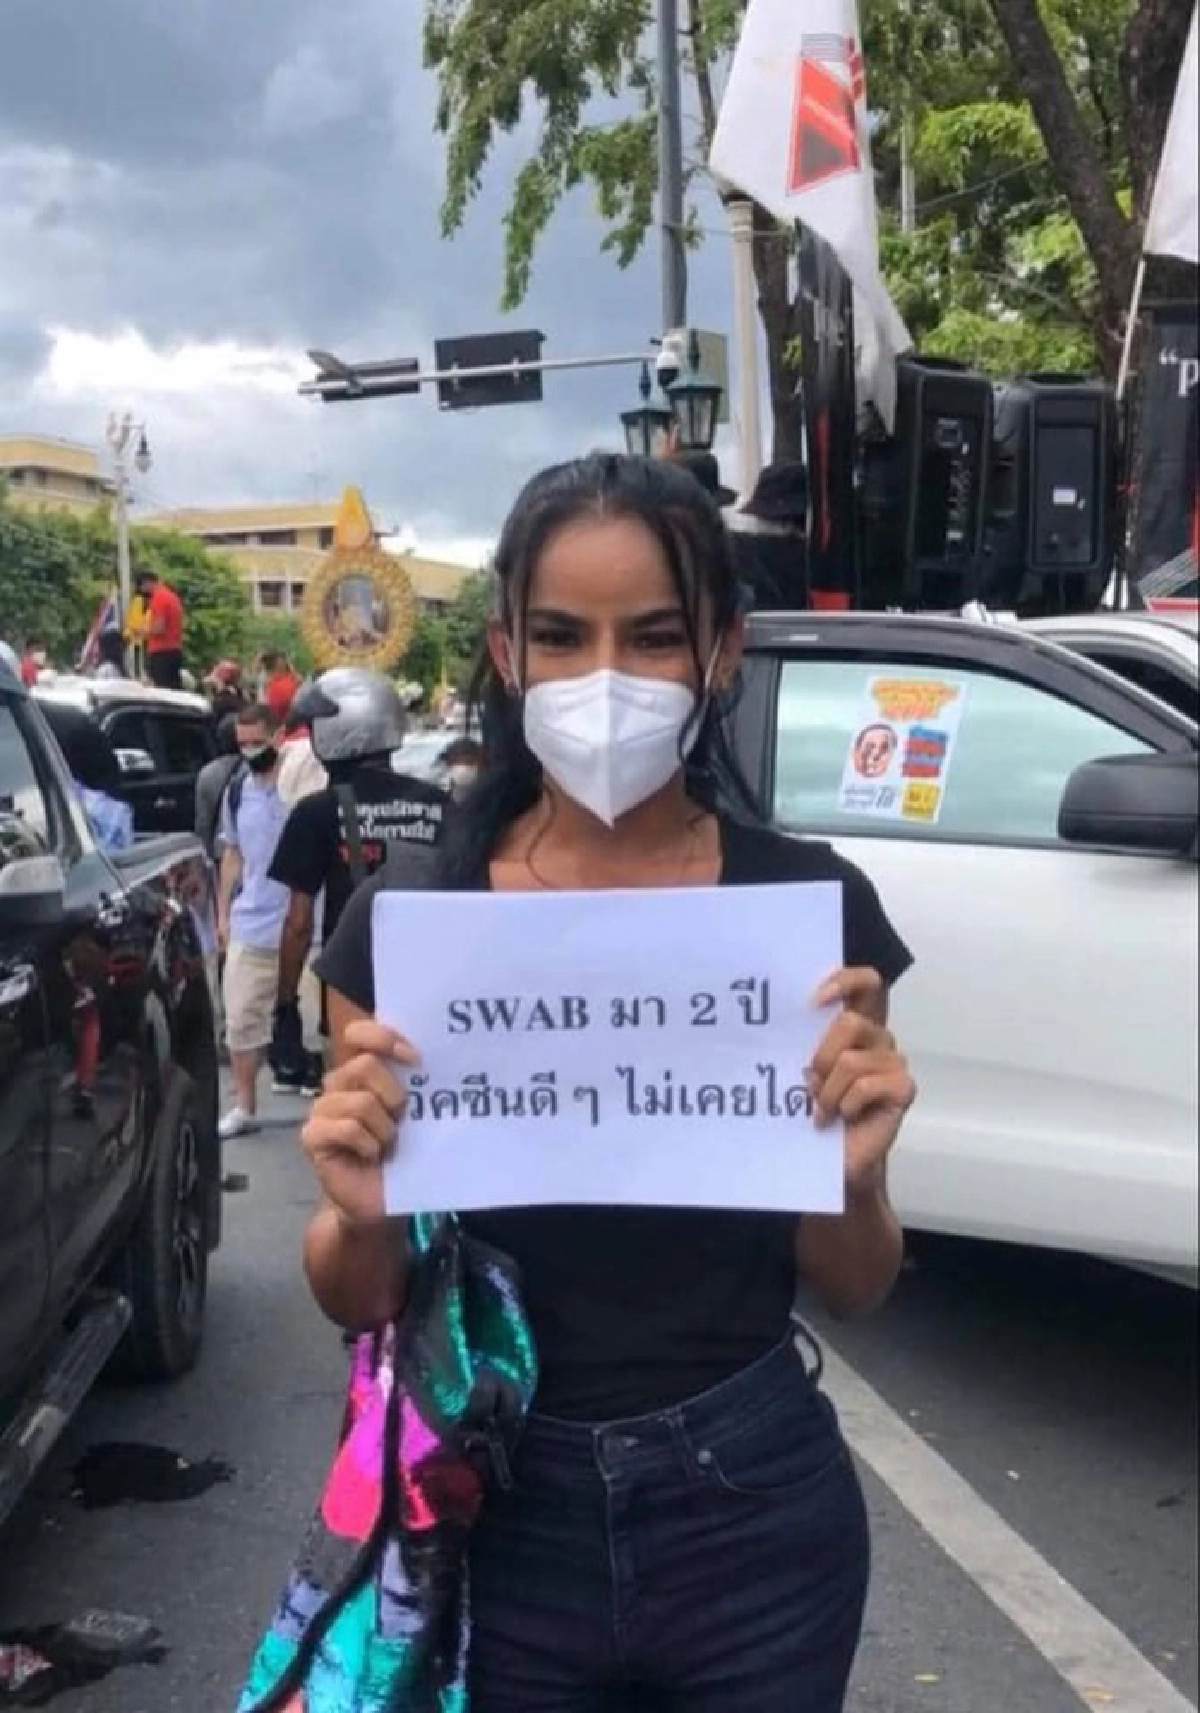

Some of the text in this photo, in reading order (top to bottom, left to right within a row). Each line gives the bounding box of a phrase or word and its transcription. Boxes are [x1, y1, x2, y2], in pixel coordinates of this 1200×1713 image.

[447, 977, 771, 1033] SWAB มา 2 ปี
[615, 1063, 813, 1117] ไม่เคยได
